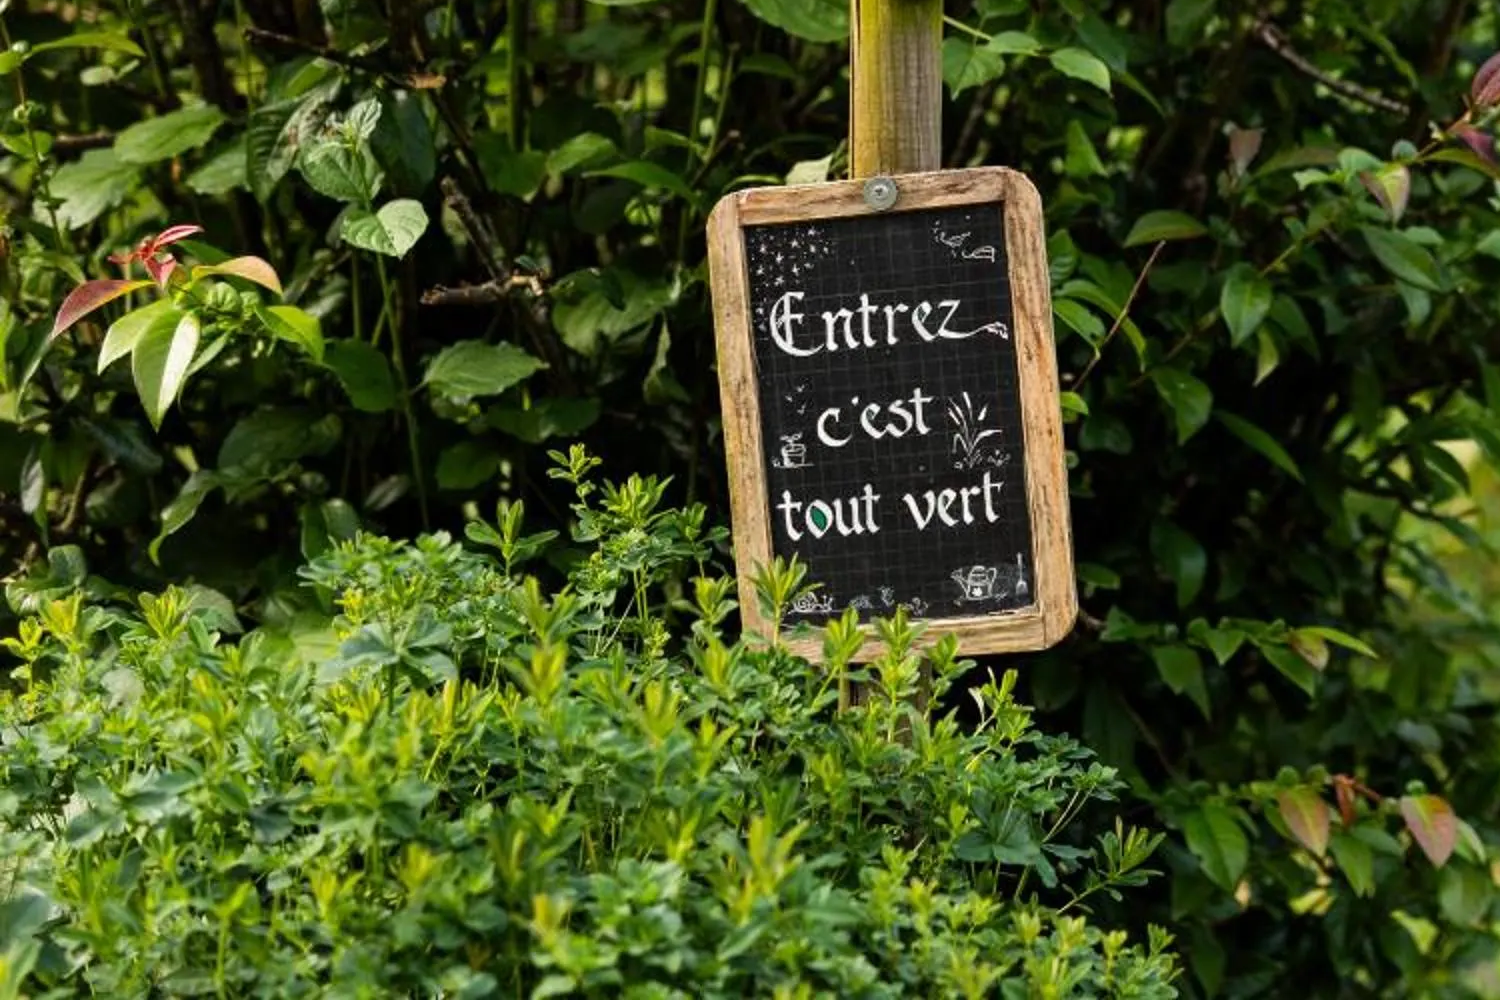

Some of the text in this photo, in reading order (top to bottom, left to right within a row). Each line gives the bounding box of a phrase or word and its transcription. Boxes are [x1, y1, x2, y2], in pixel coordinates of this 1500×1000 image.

[769, 291, 1008, 357] Entrez
[816, 388, 935, 447] c'est
[777, 471, 1004, 541] tout vert
